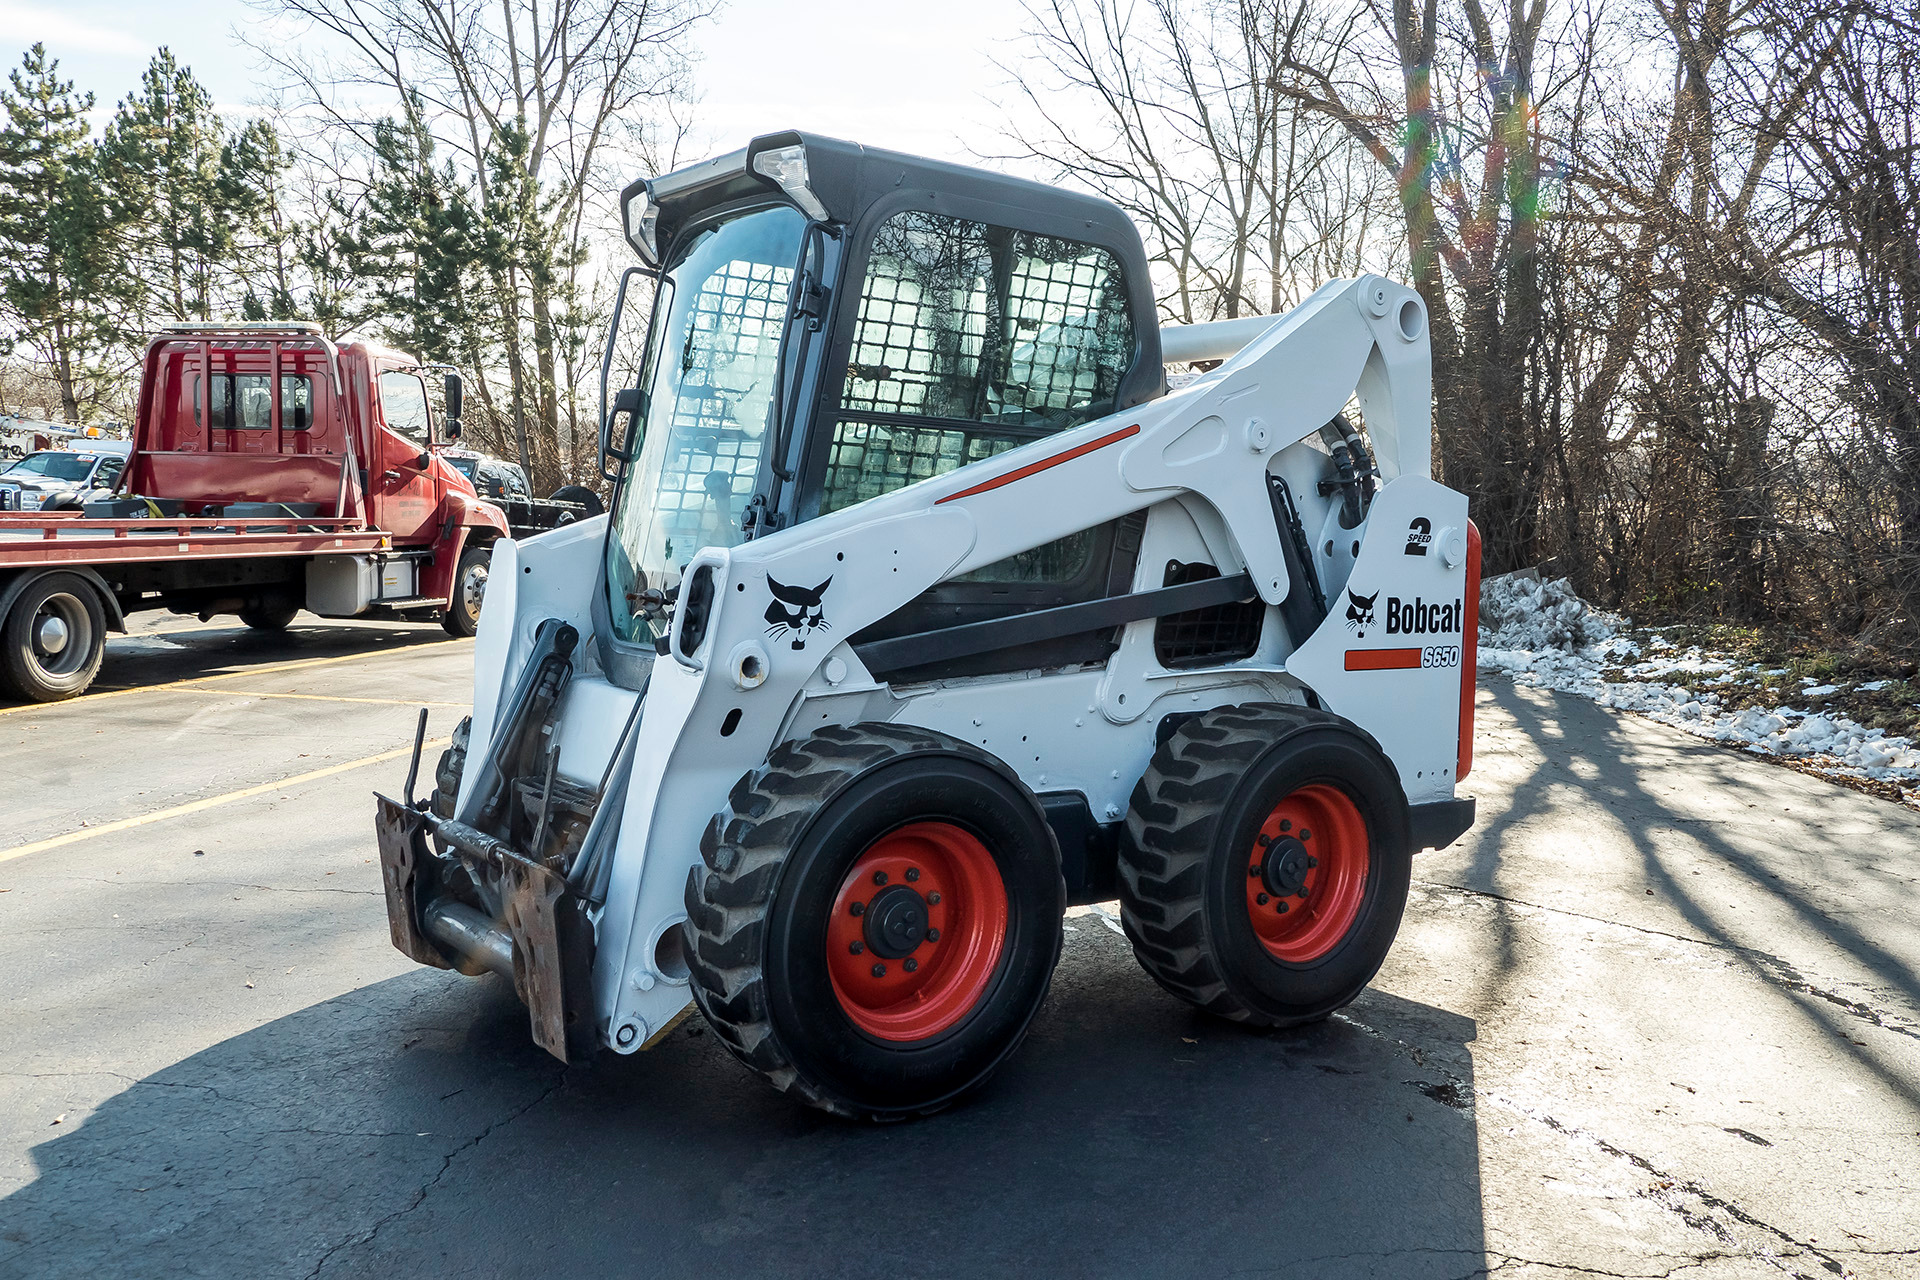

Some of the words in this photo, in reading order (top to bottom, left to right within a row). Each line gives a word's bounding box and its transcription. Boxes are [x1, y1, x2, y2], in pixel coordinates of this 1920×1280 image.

[1404, 517, 1431, 556] 2
[1407, 533, 1432, 543] SPEED
[1386, 597, 1462, 634] Bobcat
[1423, 646, 1460, 668] S650
